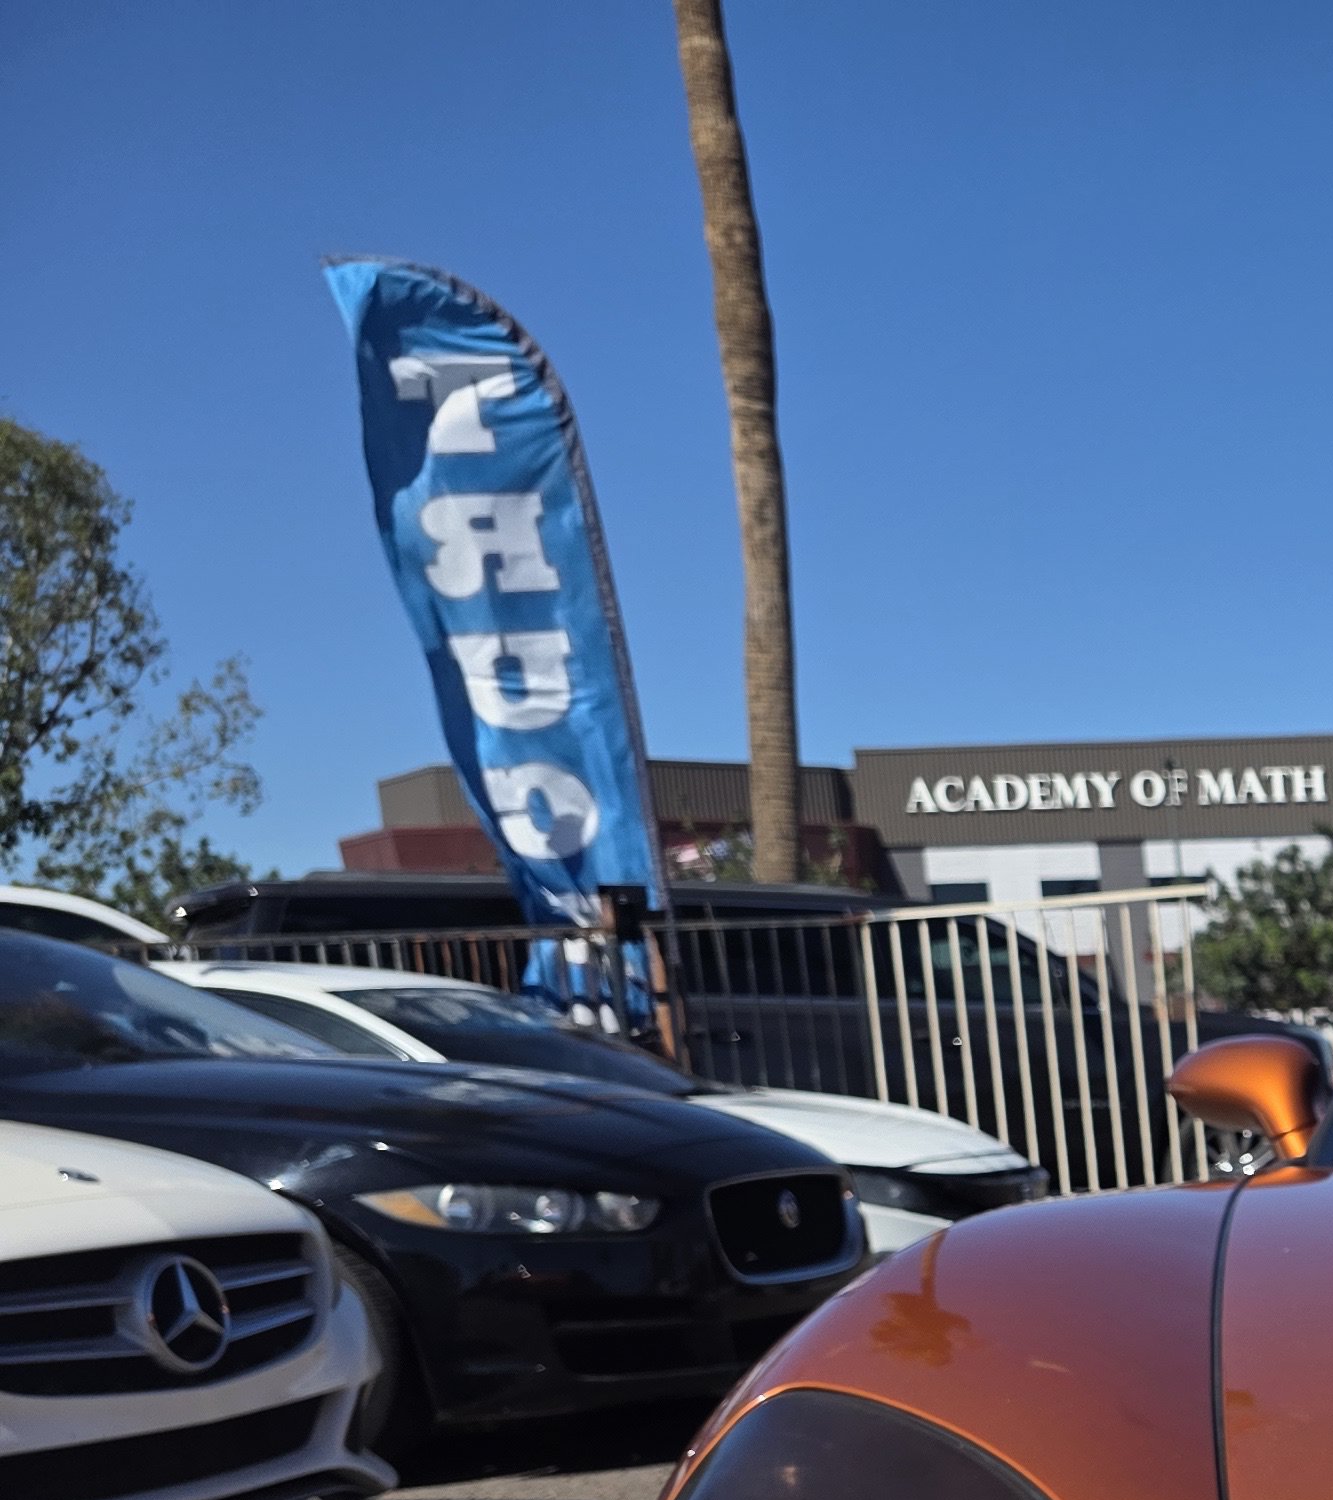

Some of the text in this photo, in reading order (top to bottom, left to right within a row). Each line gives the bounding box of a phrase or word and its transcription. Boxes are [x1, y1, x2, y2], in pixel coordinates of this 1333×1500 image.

[904, 769, 1122, 814] ACADEMY
[1129, 767, 1188, 808] OF
[1195, 764, 1327, 806] MATH
